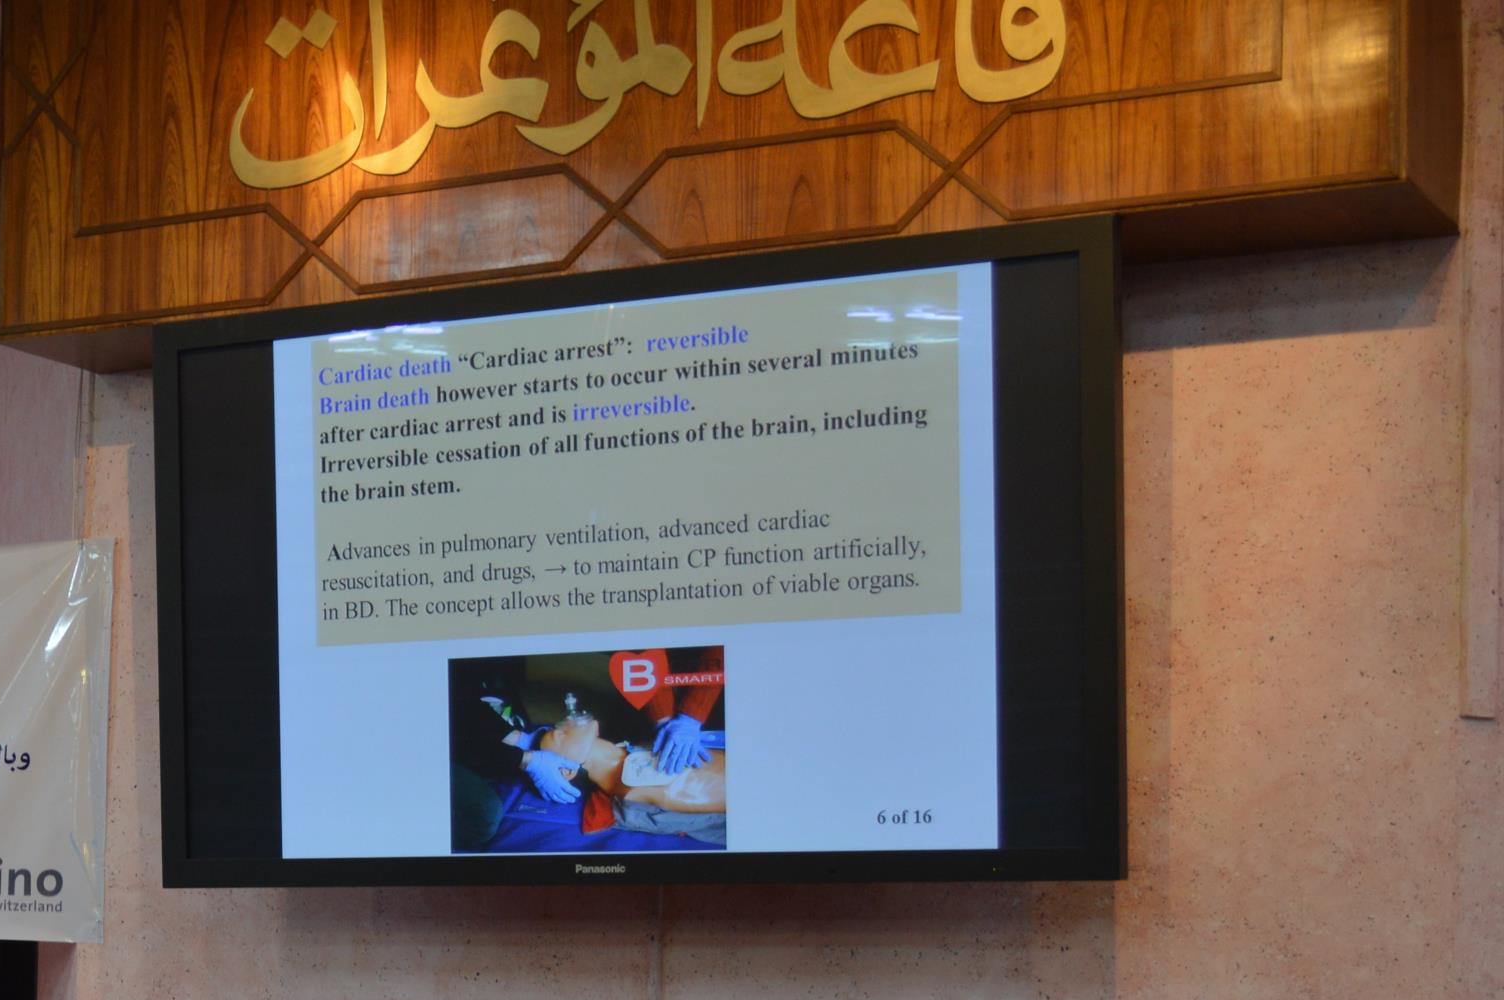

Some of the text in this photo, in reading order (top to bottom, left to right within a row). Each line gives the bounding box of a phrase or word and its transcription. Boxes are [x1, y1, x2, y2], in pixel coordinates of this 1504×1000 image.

[318, 325, 749, 386] Cardiac death “Cardiac arrest”: reversible
[319, 342, 919, 415] Brain death however starts to occur within several minutes
[319, 394, 696, 445] after cardiac arrest and is irreversible.
[320, 406, 928, 474] Irreversible cessation of all functions of the brain, including
[320, 477, 461, 503] the brain stem.
[327, 509, 830, 562] Advances in pulmonary ventilation, advanced cardiac
[321, 535, 927, 592] resuscitation, and drugs, to maintain CP function artificially,
[323, 570, 919, 621] in BD. The concept allows the transplantation of viable organs.
[622, 658, 724, 692] B SMART
[876, 808, 933, 825] 6 of 16
[575, 863, 626, 875] Panasonic
